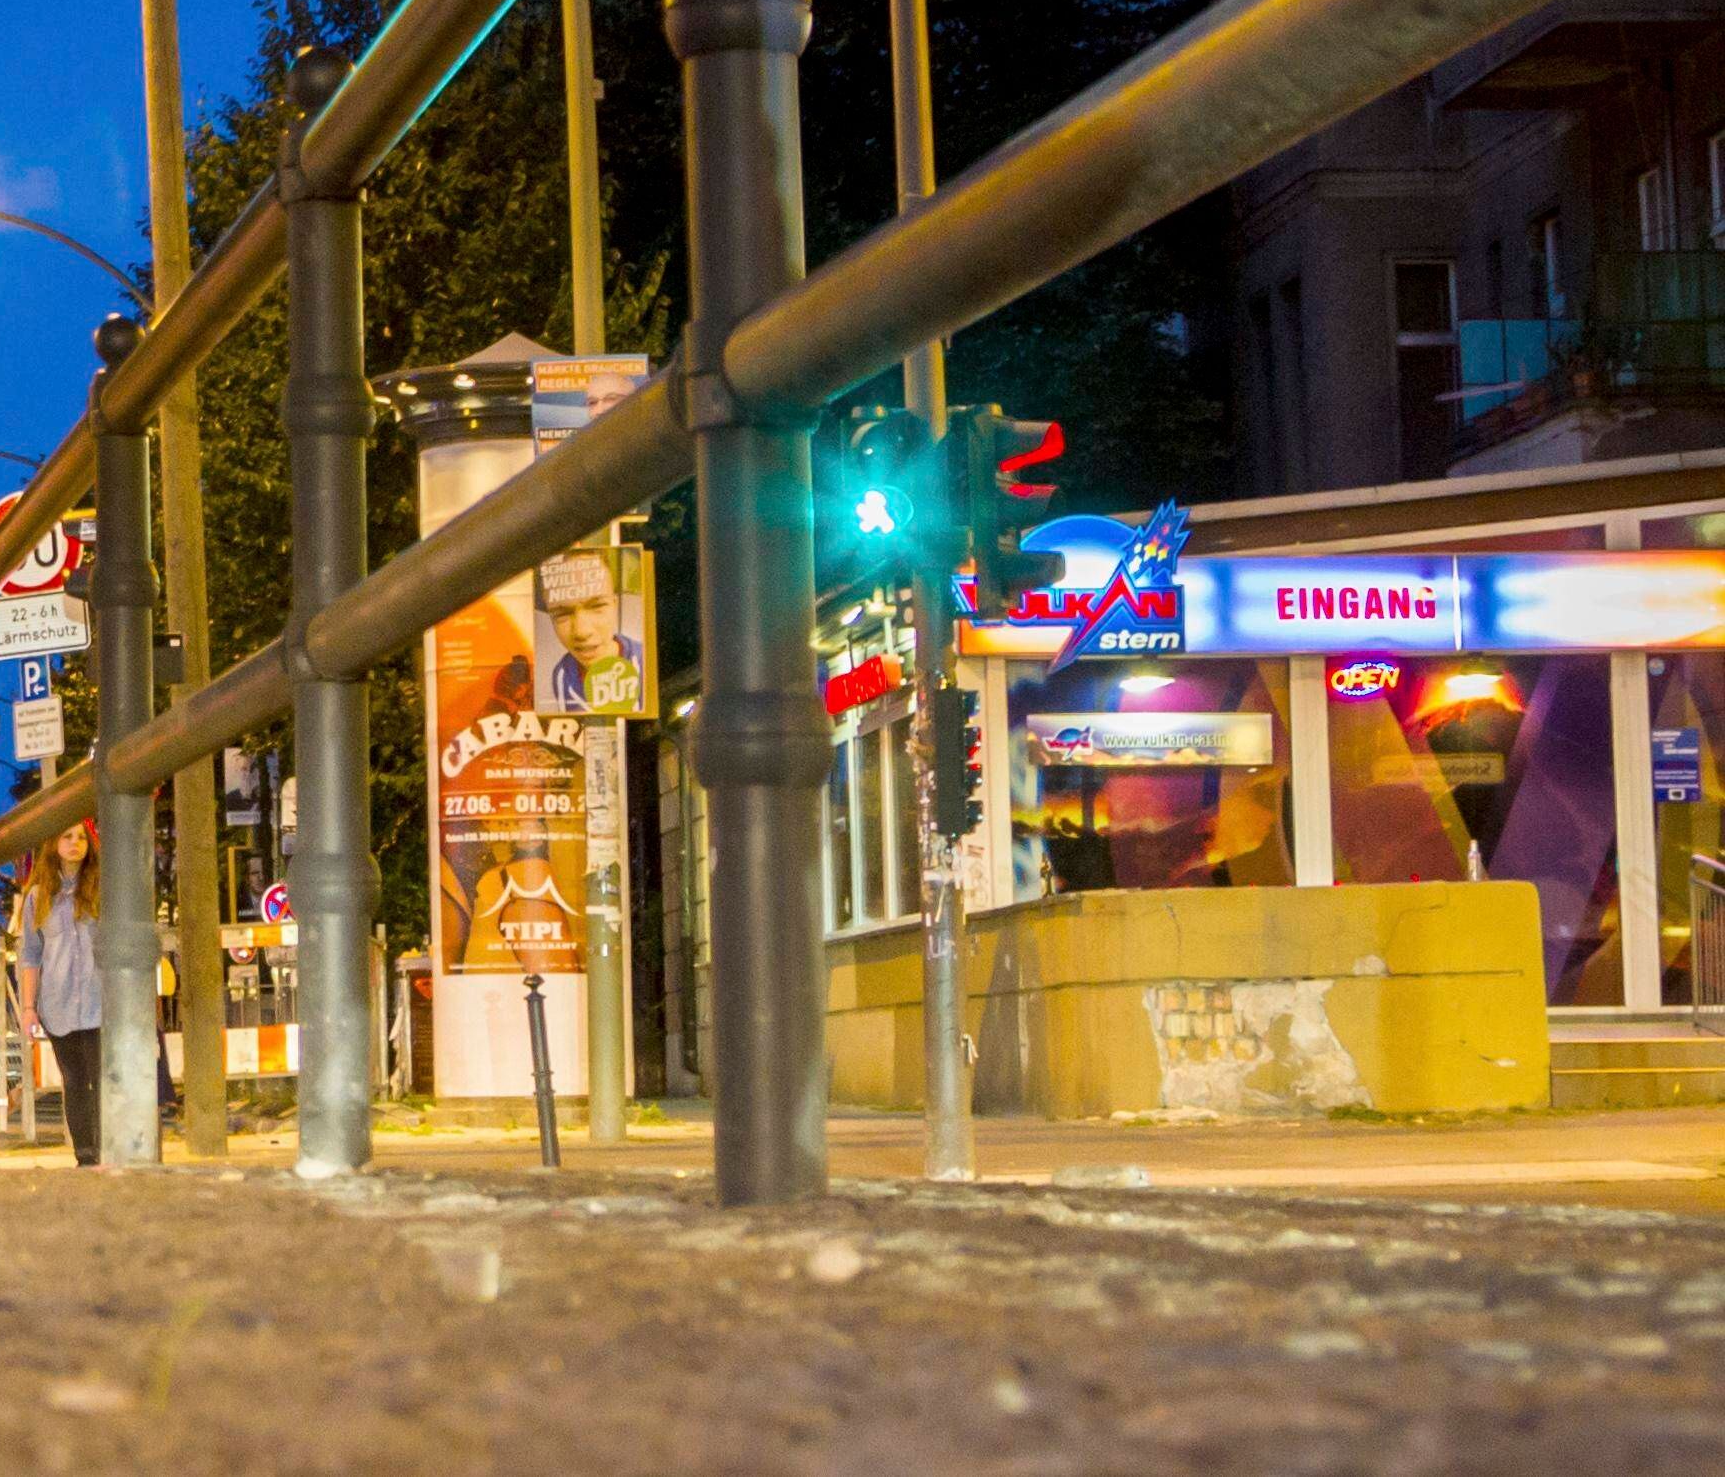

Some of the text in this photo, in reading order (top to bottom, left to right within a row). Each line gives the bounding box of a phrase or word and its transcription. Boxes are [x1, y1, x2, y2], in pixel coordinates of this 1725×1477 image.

[543, 568, 606, 590] WILL ICH
[11, 608, 29, 622] 22
[51, 604, 59, 617] h
[1277, 587, 1436, 620] EINGANG
[1100, 629, 1180, 649] stern
[1331, 667, 1400, 689] OPEN
[485, 768, 574, 779] DAS MUSICAL
[445, 795, 497, 816] 27.06.
[515, 794, 575, 813] 01.09.
[500, 921, 563, 941] TIPI
